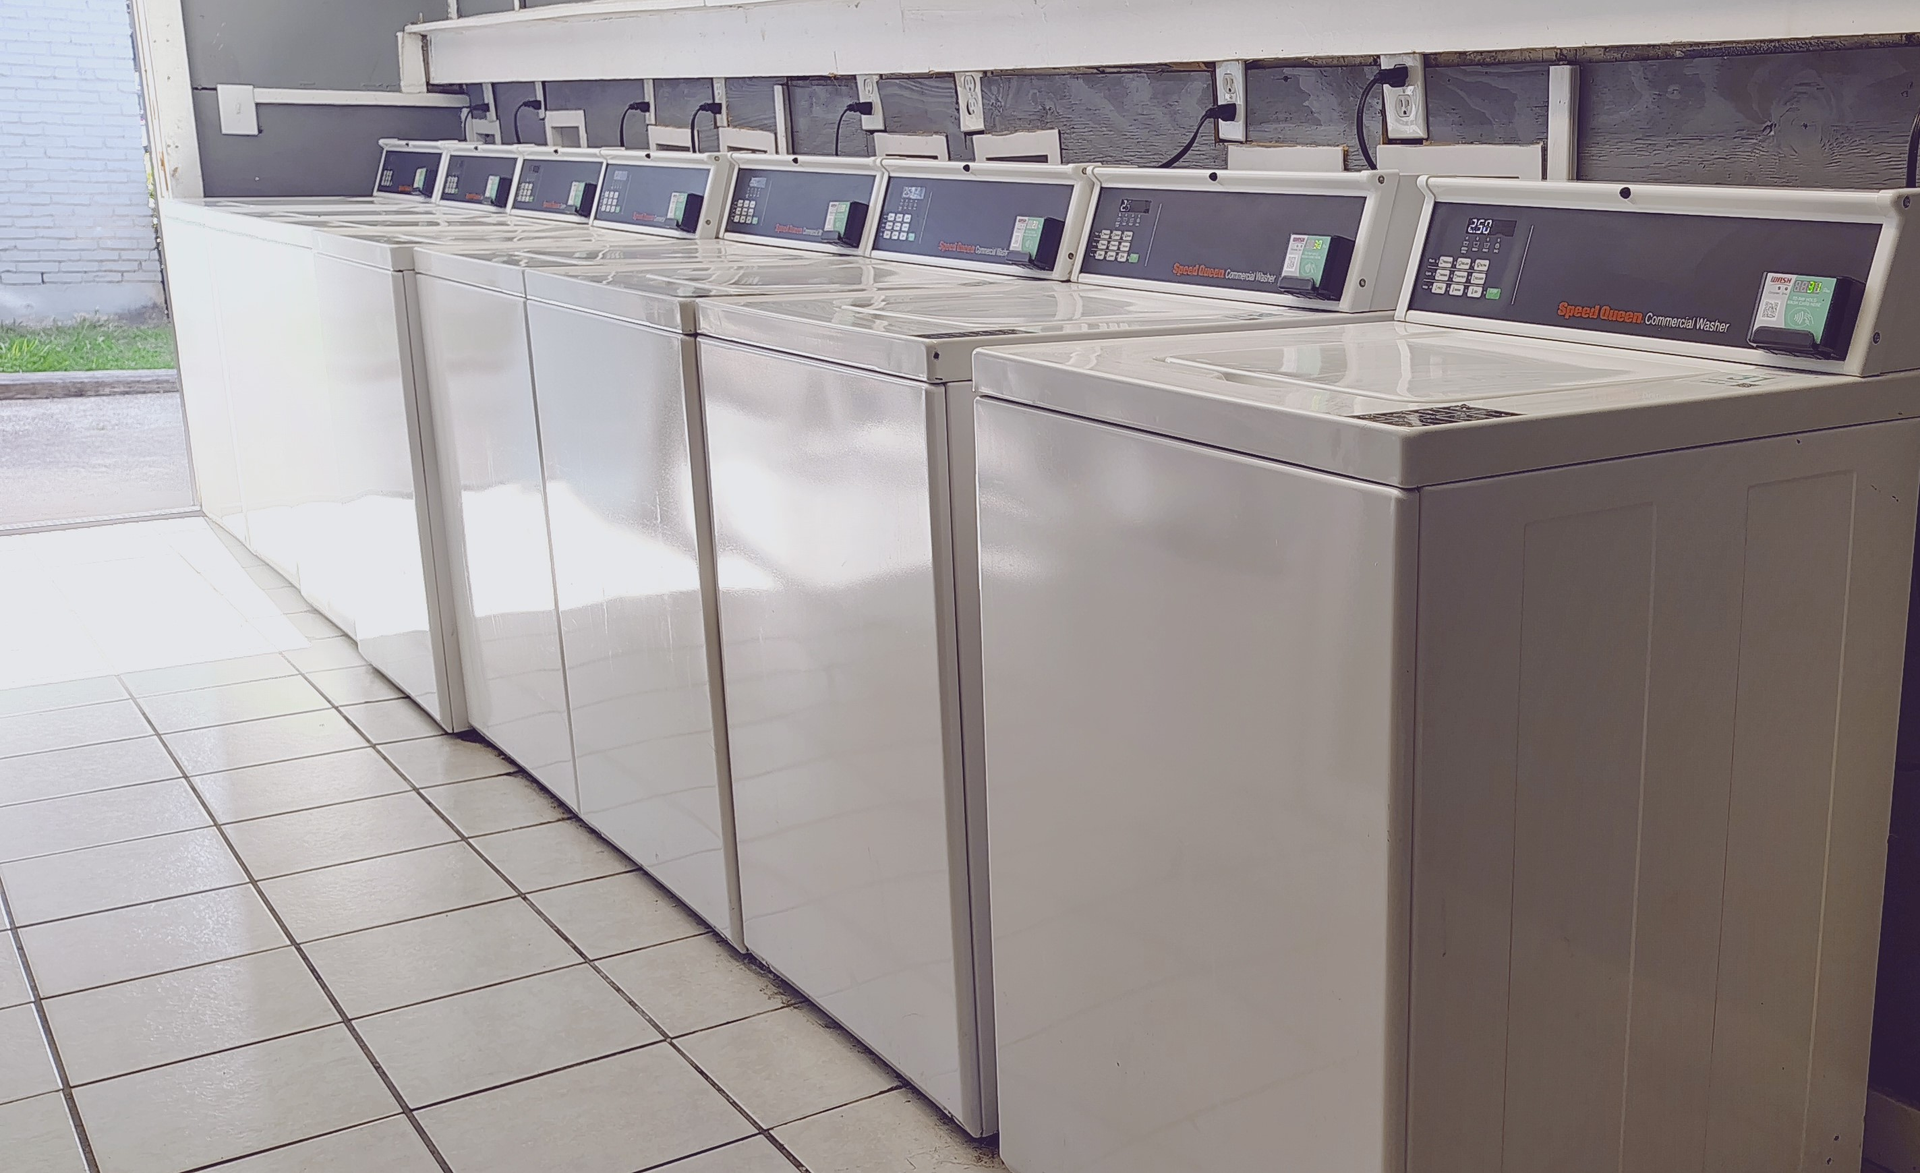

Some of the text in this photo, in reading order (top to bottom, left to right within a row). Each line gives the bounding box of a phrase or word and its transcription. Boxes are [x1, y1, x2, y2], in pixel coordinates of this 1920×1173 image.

[1172, 262, 1277, 283] Speed Queen Commercial Washer
[1558, 301, 1730, 333] Speed Queen Commercial Washer
